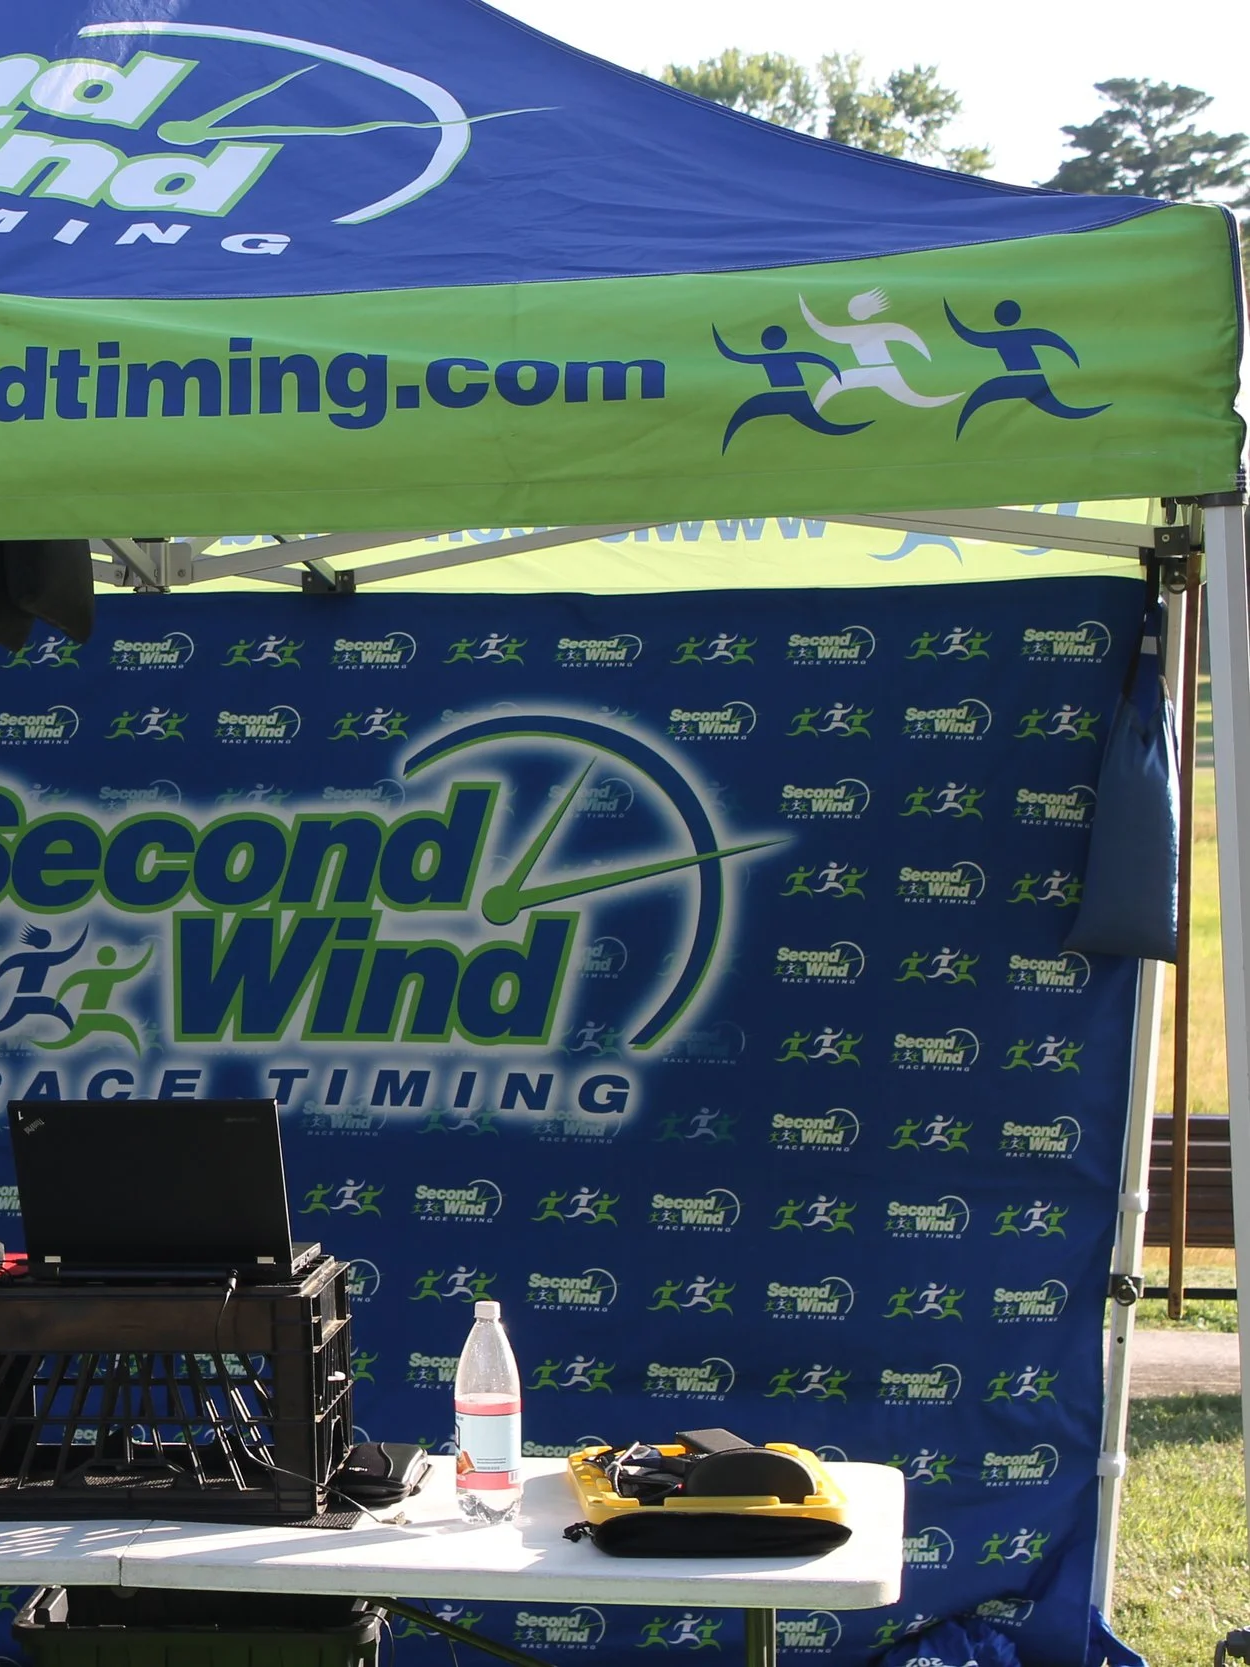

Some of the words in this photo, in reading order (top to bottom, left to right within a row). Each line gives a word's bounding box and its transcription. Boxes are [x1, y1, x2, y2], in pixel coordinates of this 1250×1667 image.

[788, 633, 852, 646] Second
[1023, 628, 1088, 641] Second
[113, 639, 173, 652] Second
[334, 638, 394, 651] Second
[557, 637, 619, 649] Second
[1053, 642, 1096, 655] Wind
[139, 651, 180, 663] Wind
[361, 651, 402, 663] Wind
[586, 649, 627, 660] Wind
[817, 645, 860, 658] Wind
[218, 711, 279, 724] Second
[670, 708, 733, 721] Second
[905, 706, 968, 720] Second
[24, 725, 64, 738] Wind
[245, 724, 286, 737] Wind
[698, 721, 741, 733] Wind
[934, 720, 976, 733] Wind
[782, 785, 846, 798] Second
[1017, 788, 1078, 806] Second
[811, 799, 855, 812] Wind
[1045, 804, 1085, 820] Wind
[900, 867, 962, 882] Second
[928, 882, 970, 897] Wind
[777, 947, 841, 962] Second
[806, 962, 849, 977] Wind
[1009, 955, 1068, 971] Second
[172, 910, 581, 1045] Wind
[1036, 970, 1076, 986] Wind
[894, 1033, 956, 1049] Second
[922, 1049, 964, 1064] Wind
[268, 1068, 630, 1113] TIMING
[772, 1114, 836, 1129] Second
[801, 1129, 844, 1144] Wind
[1003, 1122, 1061, 1137] Second
[1029, 1137, 1068, 1151] Wind
[415, 1185, 479, 1200] Second
[444, 1200, 487, 1215] Wind
[652, 1194, 716, 1210] Second
[888, 1202, 947, 1216] Second
[681, 1209, 725, 1224] Wind
[915, 1216, 955, 1231] Wind
[528, 1273, 593, 1289] Second
[558, 1289, 602, 1304] Wind
[768, 1282, 831, 1298] Second
[995, 1287, 1049, 1302] Second
[796, 1298, 839, 1313] Wind
[1019, 1301, 1055, 1315] Wind
[647, 1363, 712, 1378] Second
[881, 1370, 941, 1384] Second
[676, 1378, 719, 1392] Wind
[908, 1384, 948, 1398] Wind
[984, 1451, 1039, 1466] Second
[1008, 1464, 1045, 1479] Wind
[516, 1613, 581, 1628] Second
[546, 1627, 590, 1642] Wind
